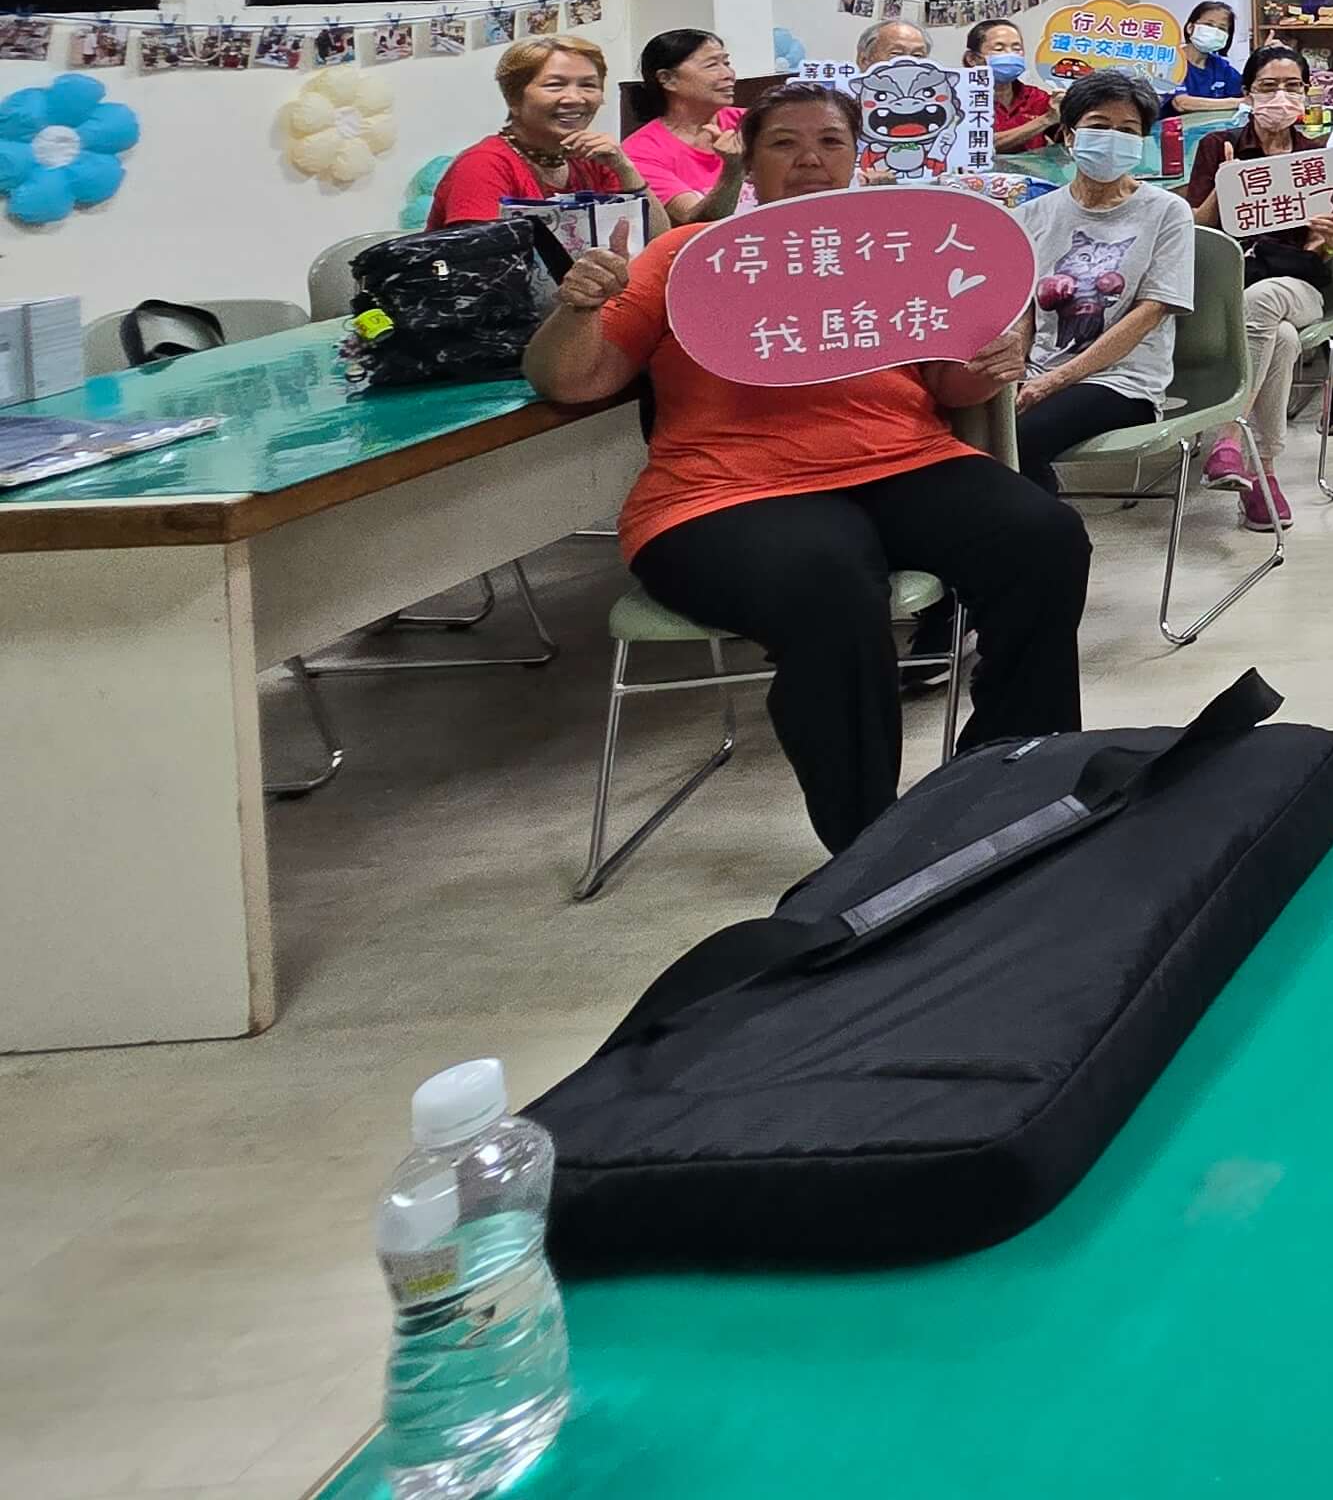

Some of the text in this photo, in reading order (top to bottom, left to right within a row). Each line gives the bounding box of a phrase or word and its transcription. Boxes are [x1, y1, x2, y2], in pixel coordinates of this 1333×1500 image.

[1052, 33, 1175, 62] 遵守交通規則
[1073, 12, 1162, 40] 行人也要
[968, 70, 990, 169] 喝酒不開車
[1238, 156, 1327, 198] 停讓
[705, 223, 976, 284] 停讓行人
[750, 297, 950, 360] 我驕傲
